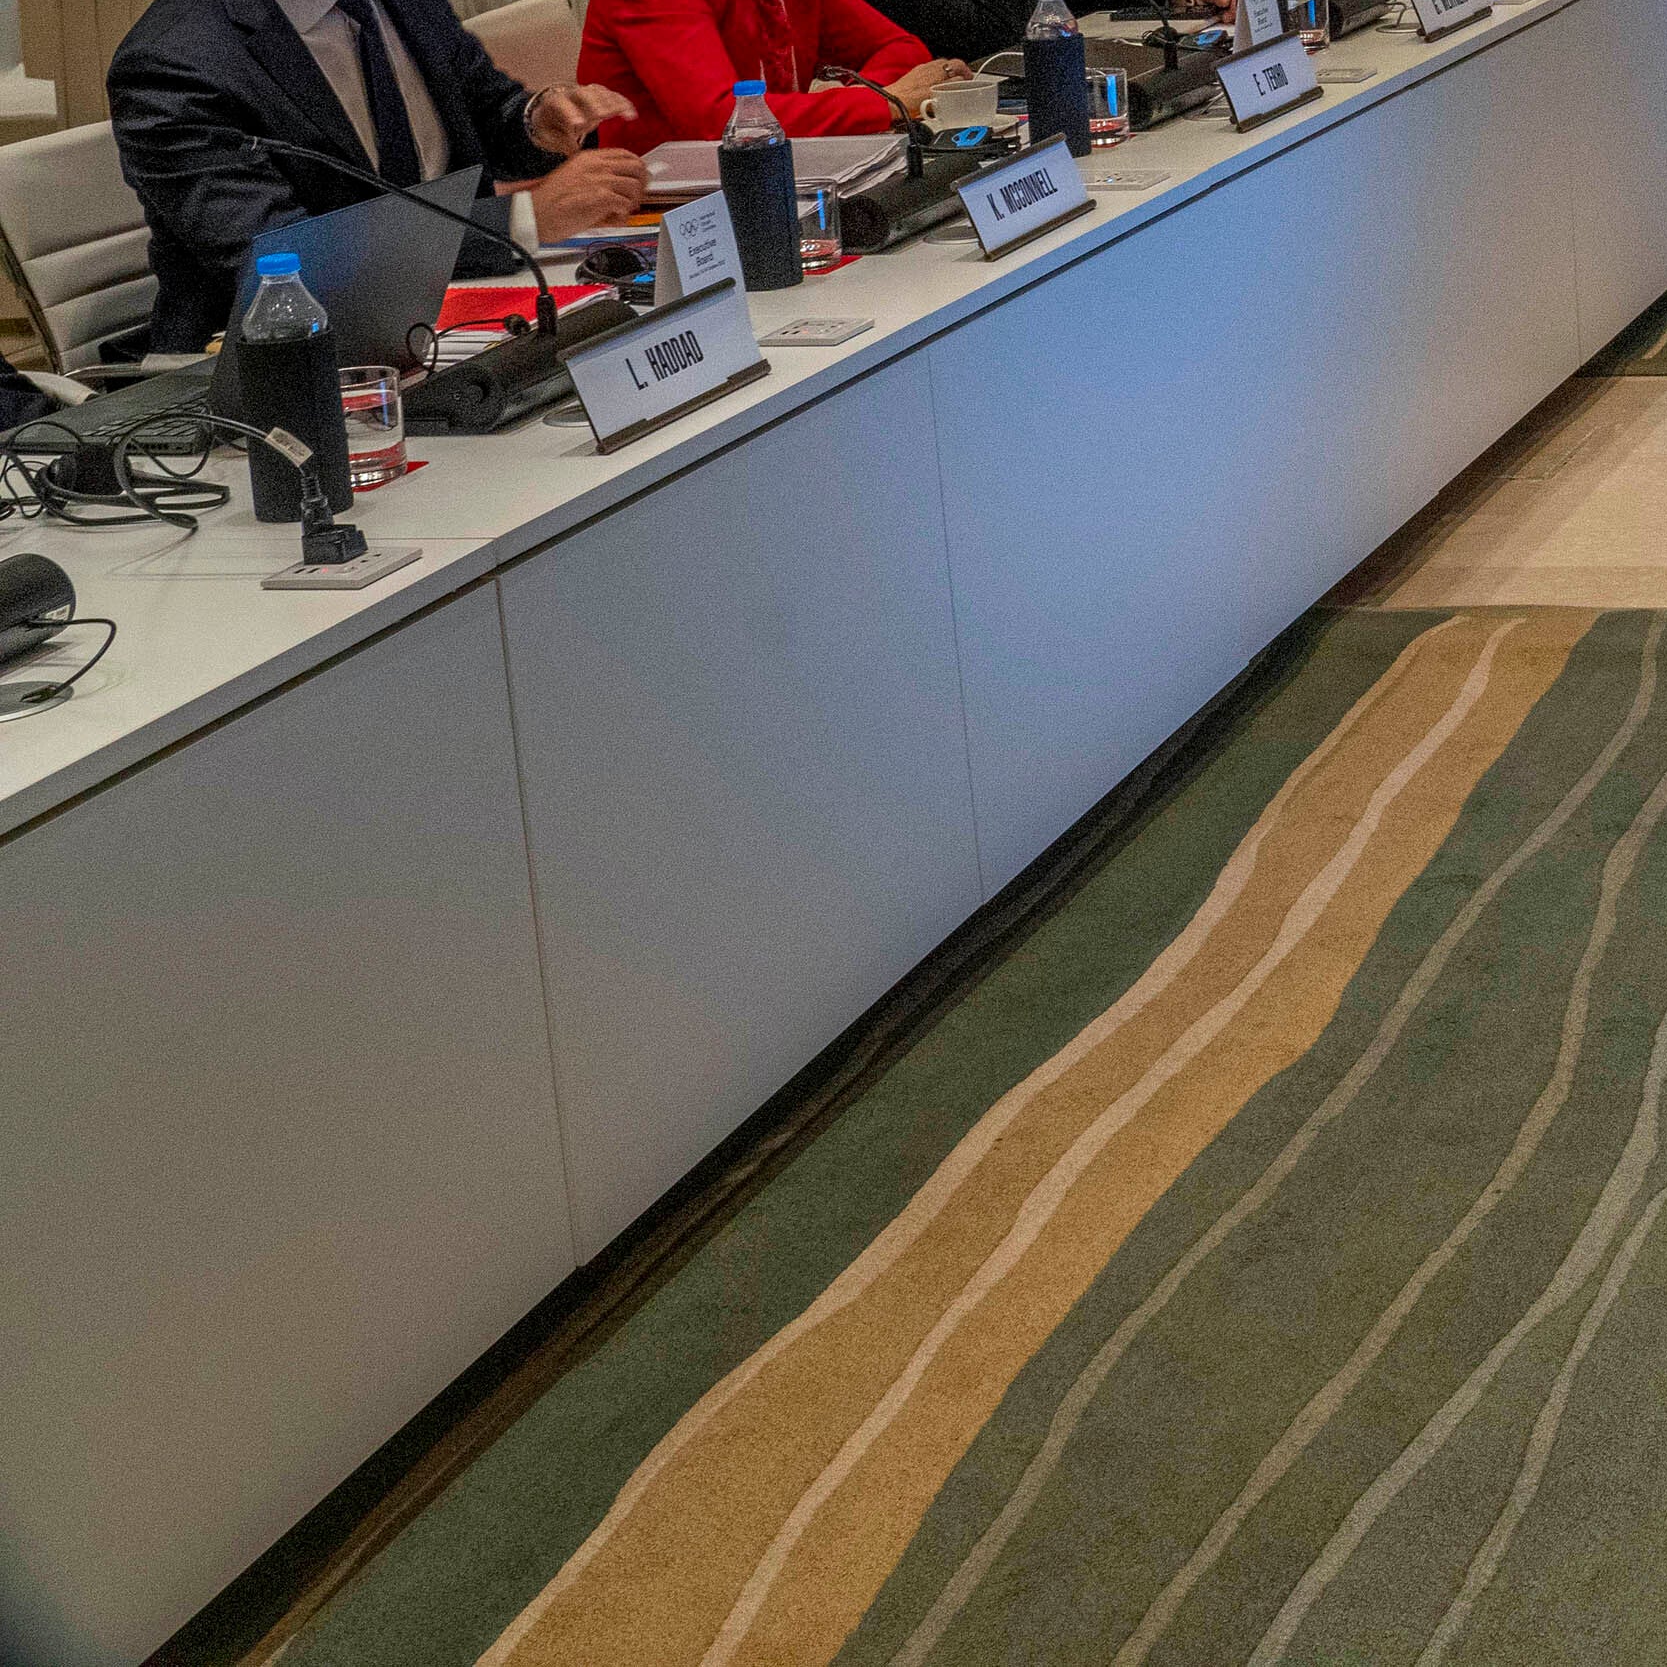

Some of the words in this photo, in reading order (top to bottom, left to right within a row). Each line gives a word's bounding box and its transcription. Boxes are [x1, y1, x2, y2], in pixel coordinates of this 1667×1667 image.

[986, 192, 1005, 221] K.
[1000, 167, 1058, 215] MCCONNELL
[625, 357, 649, 391] L.
[644, 329, 704, 382] HADDAD
